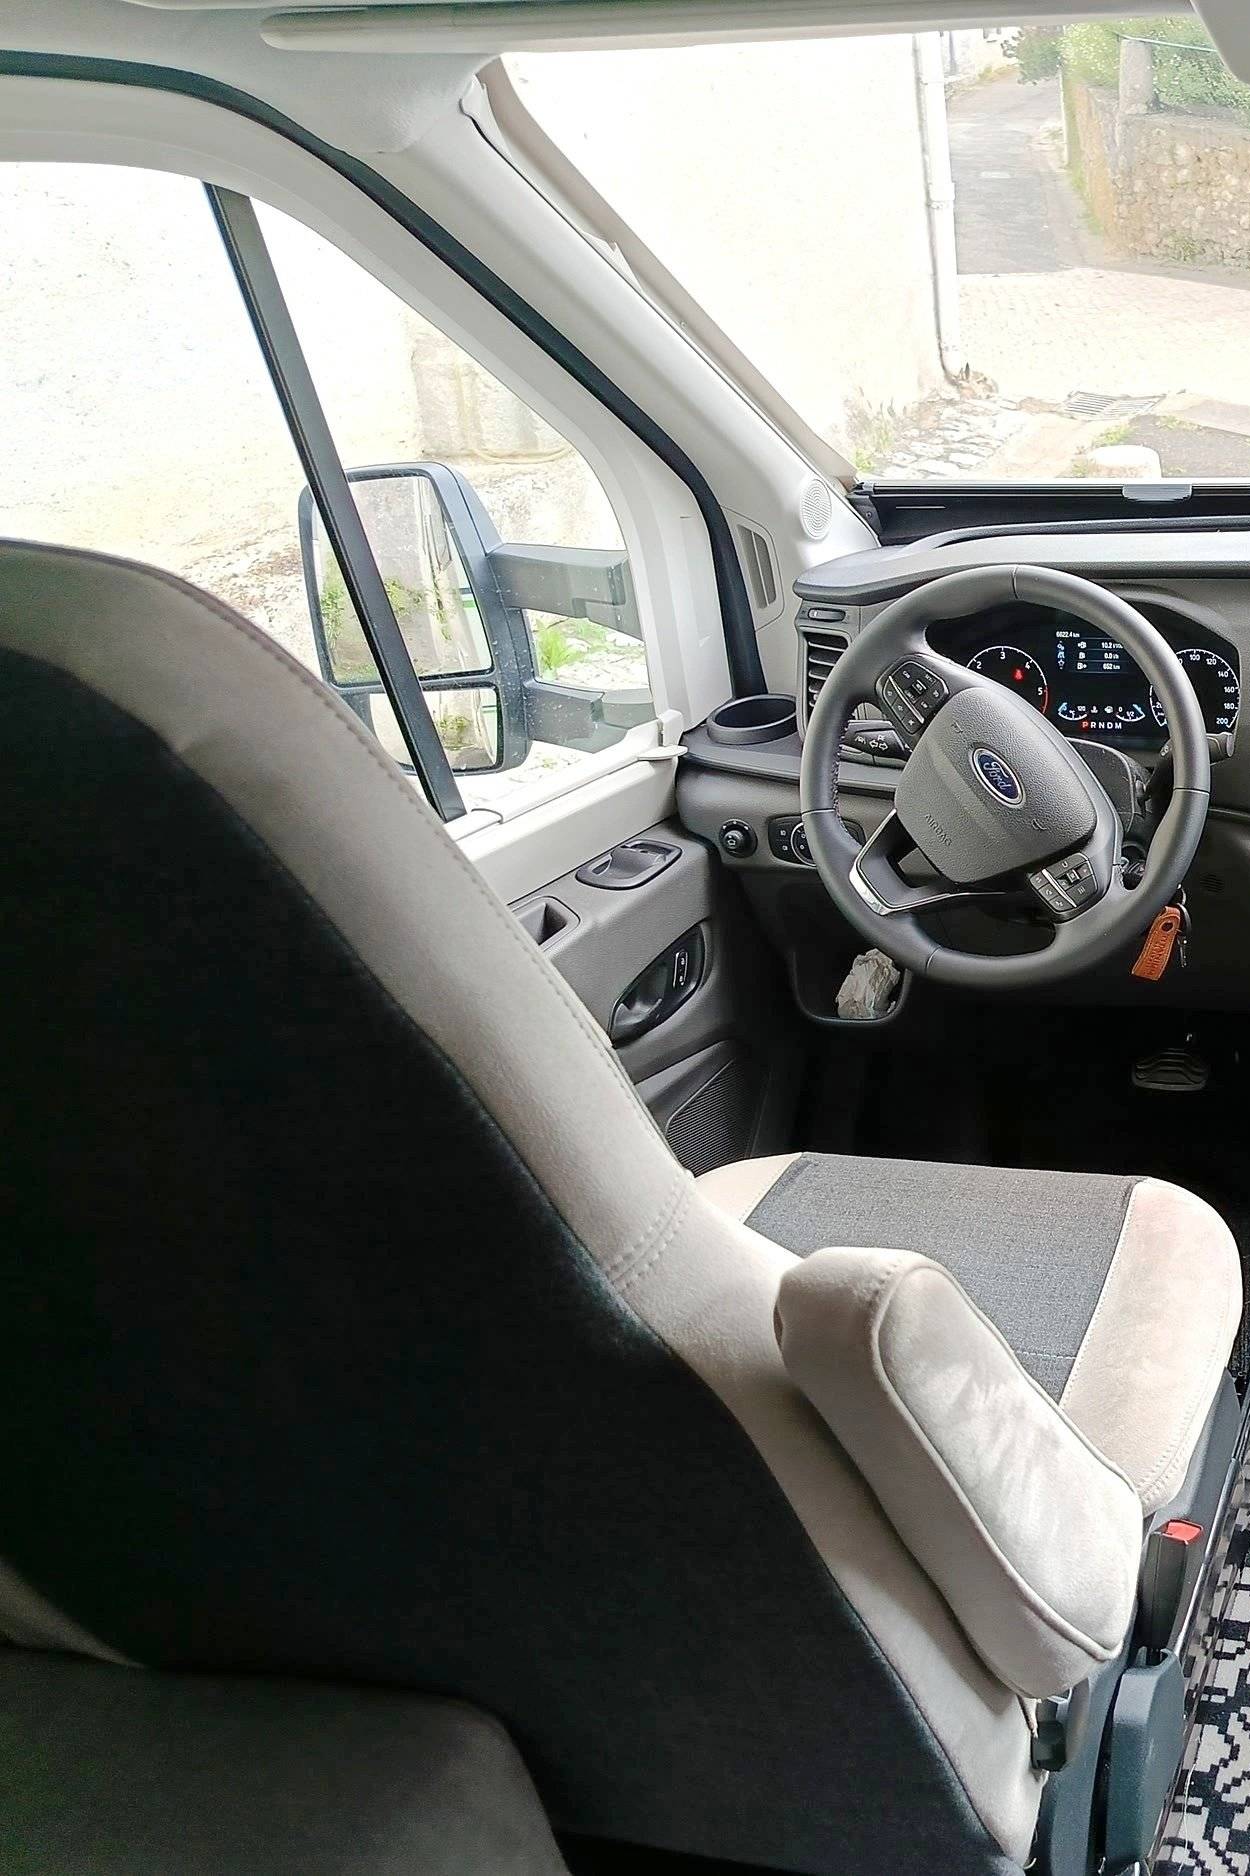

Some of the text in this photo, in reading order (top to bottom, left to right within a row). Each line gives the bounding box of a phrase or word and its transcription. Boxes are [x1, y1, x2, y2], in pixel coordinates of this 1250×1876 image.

[1000, 651, 1006, 660] 3
[976, 661, 982, 669] 2
[1025, 662, 1031, 670] 4
[1037, 687, 1043, 696] 5
[1090, 721, 1096, 729] R
[1098, 721, 1105, 729] N
[1106, 721, 1113, 729] D
[1114, 721, 1122, 729] M
[1216, 717, 1229, 725] 200
[924, 813, 953, 847] AIRBAG
